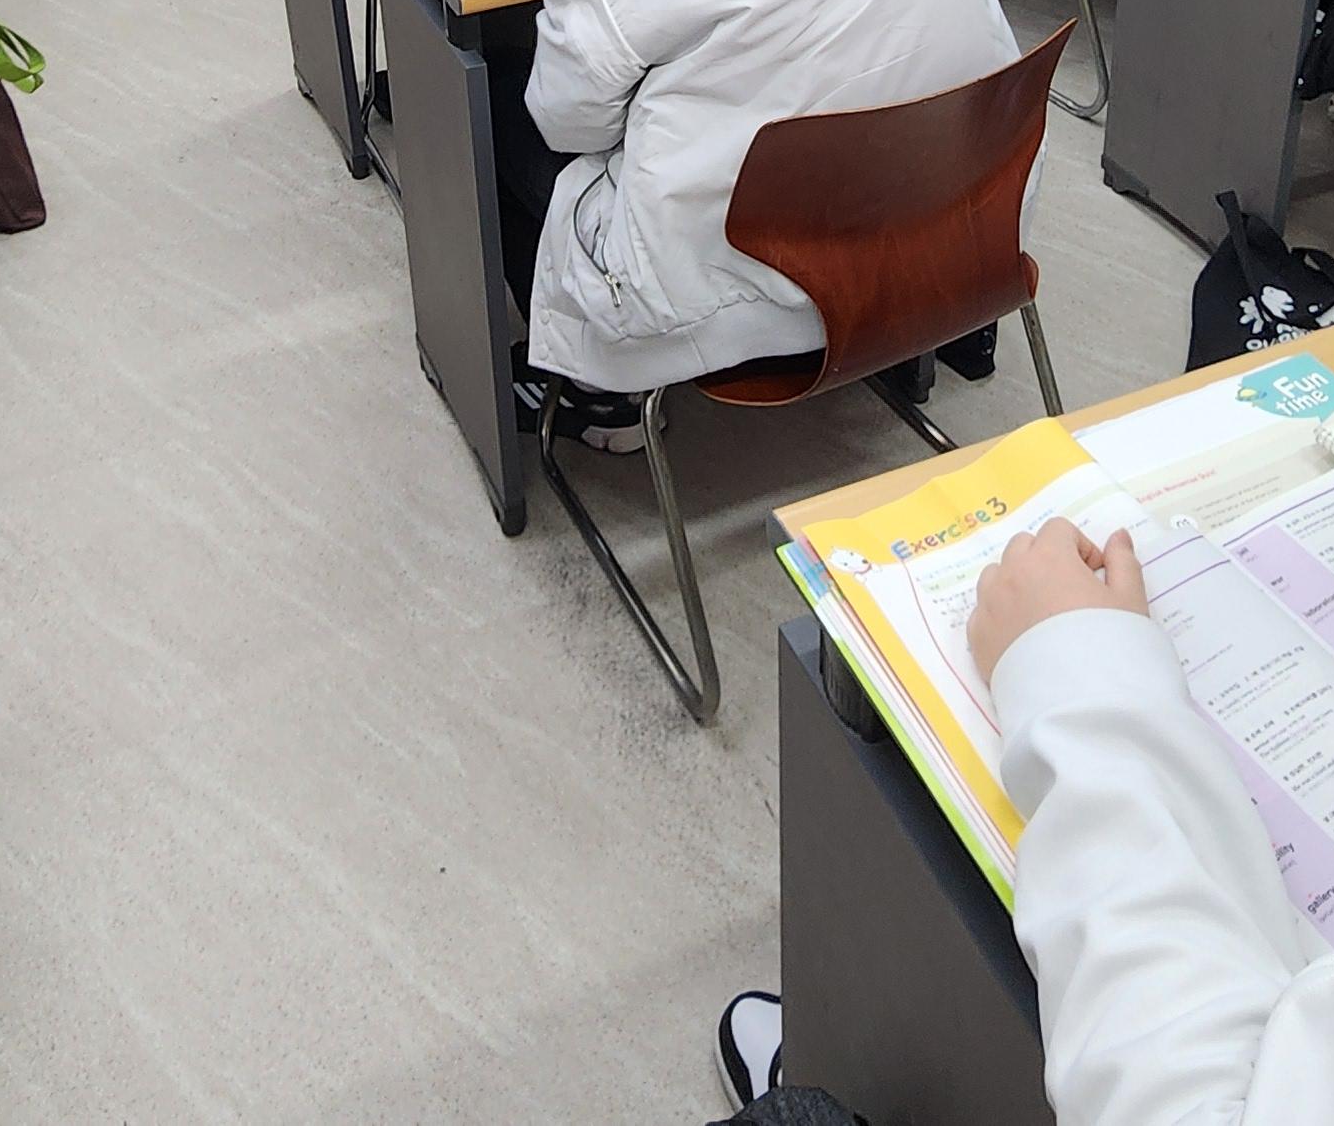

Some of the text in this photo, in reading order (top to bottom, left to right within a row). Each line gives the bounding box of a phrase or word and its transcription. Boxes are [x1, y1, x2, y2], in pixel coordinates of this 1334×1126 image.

[1273, 372, 1329, 399] Fun
[1276, 390, 1329, 416] time
[891, 496, 1007, 560] Exercise 3
